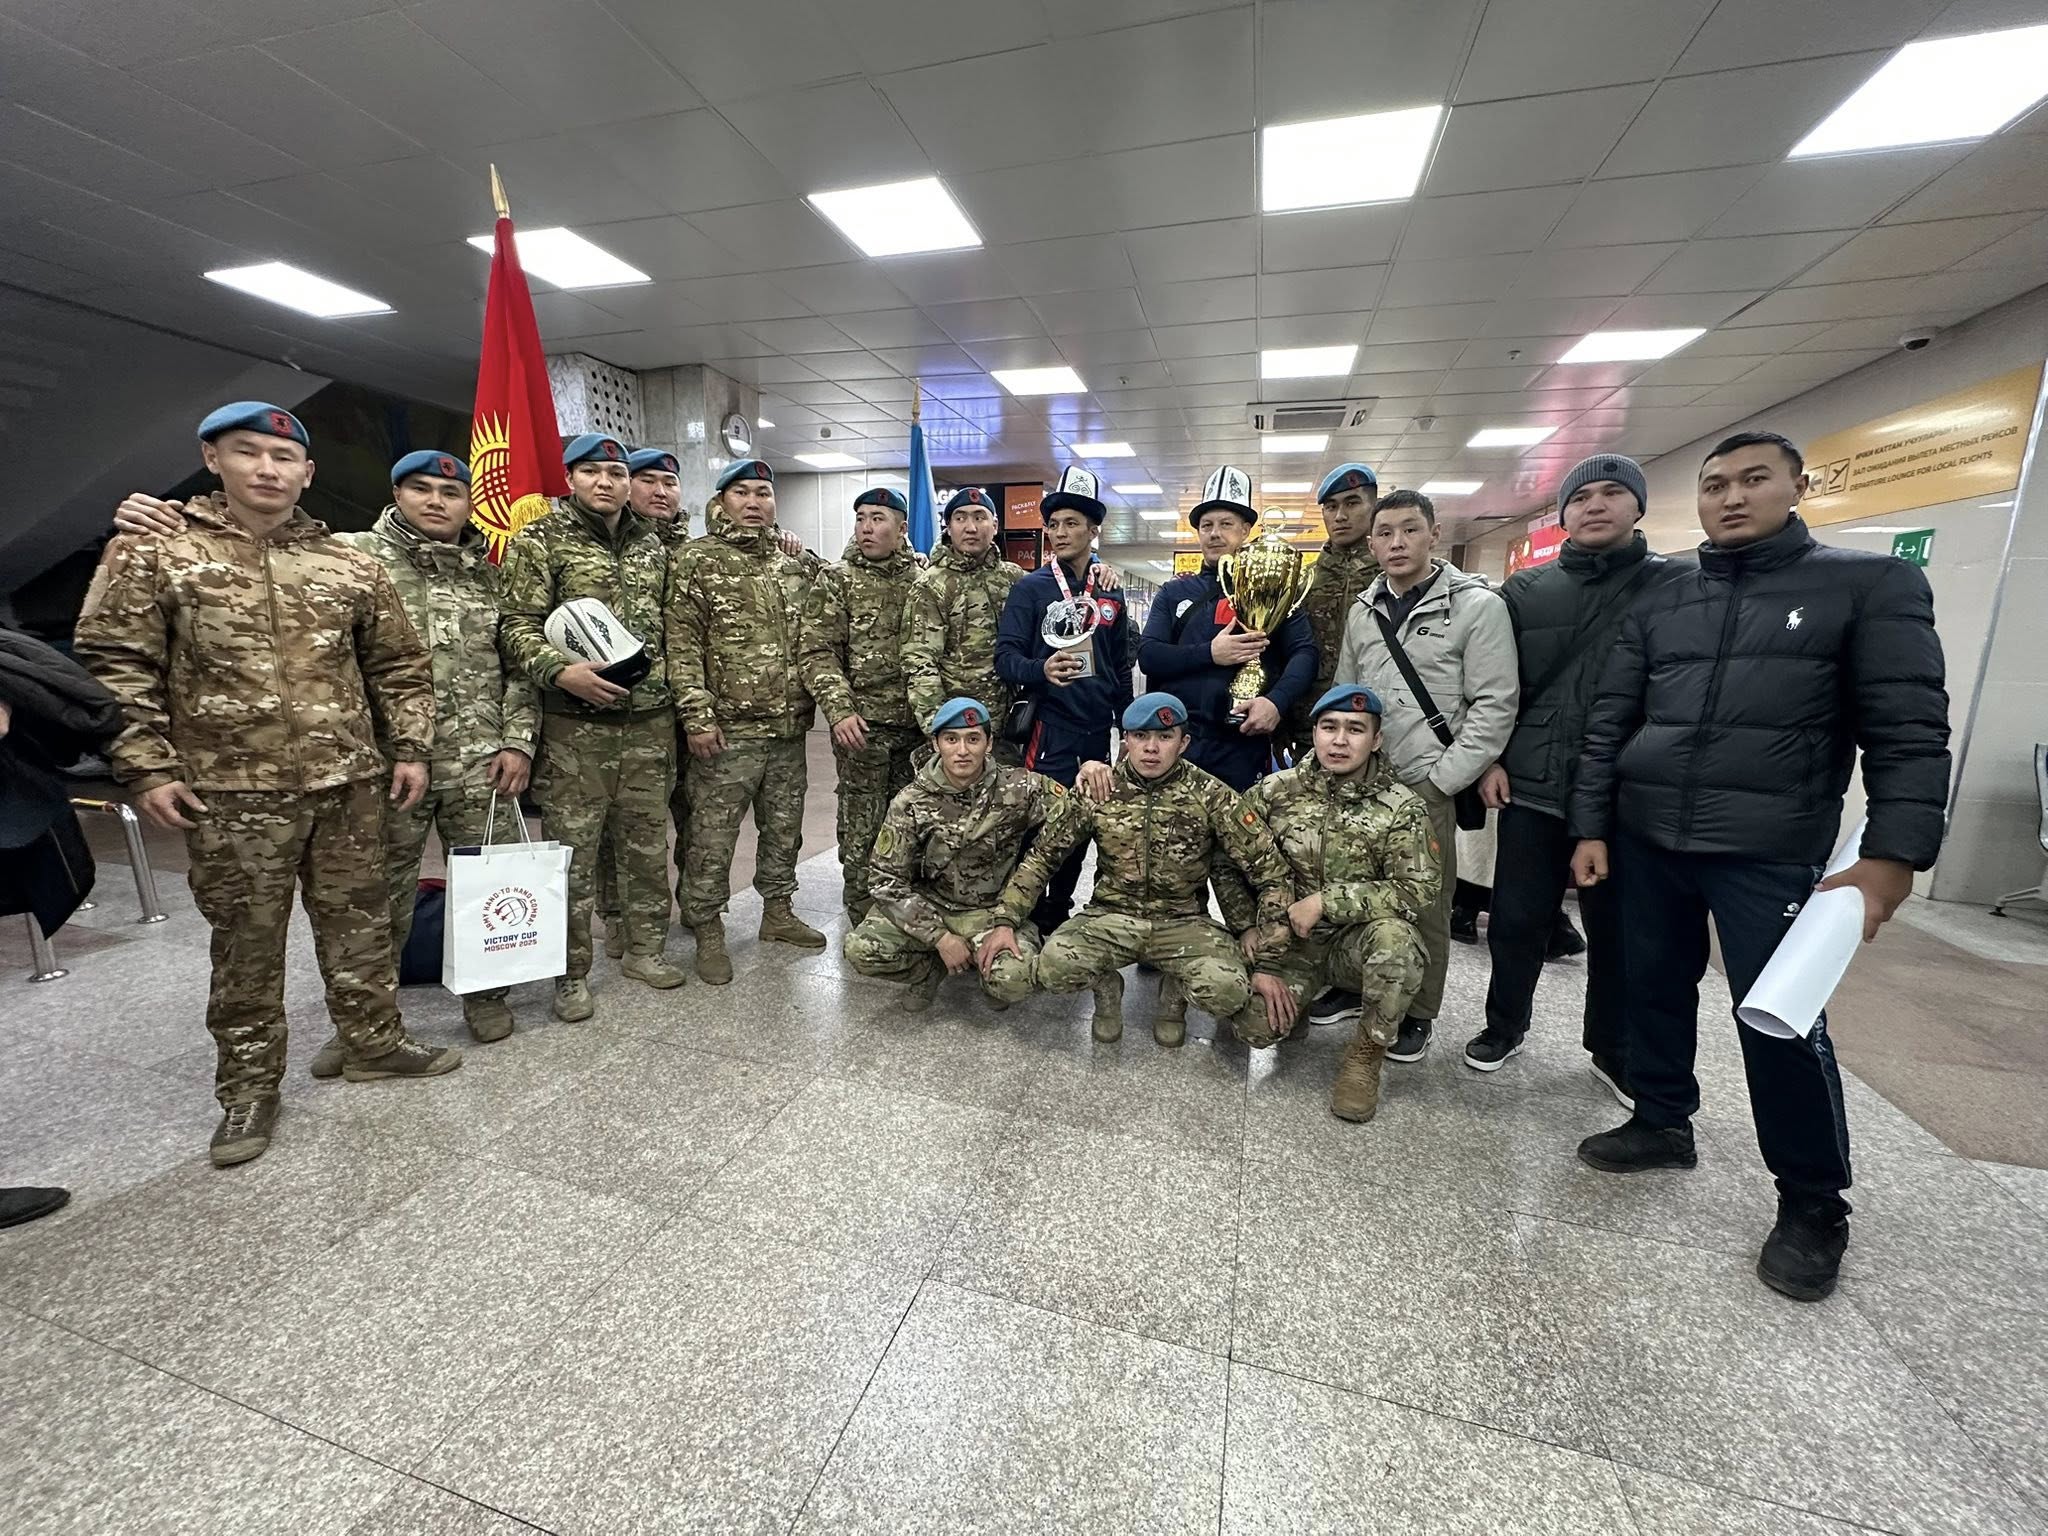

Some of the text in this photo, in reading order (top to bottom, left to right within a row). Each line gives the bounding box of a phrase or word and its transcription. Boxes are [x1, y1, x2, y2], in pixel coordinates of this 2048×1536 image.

[1938, 436, 1980, 453] МЕСТНЫХ
[1916, 465, 1931, 475] FOR
[1932, 460, 1957, 472] LOCAL
[1959, 450, 1993, 465] FLIGHTS
[482, 913, 496, 931] ARMY
[526, 899, 538, 927] COMBAT
[484, 931, 538, 945] VICTORY CUP
[484, 939, 538, 952] MOSCOW 2025
